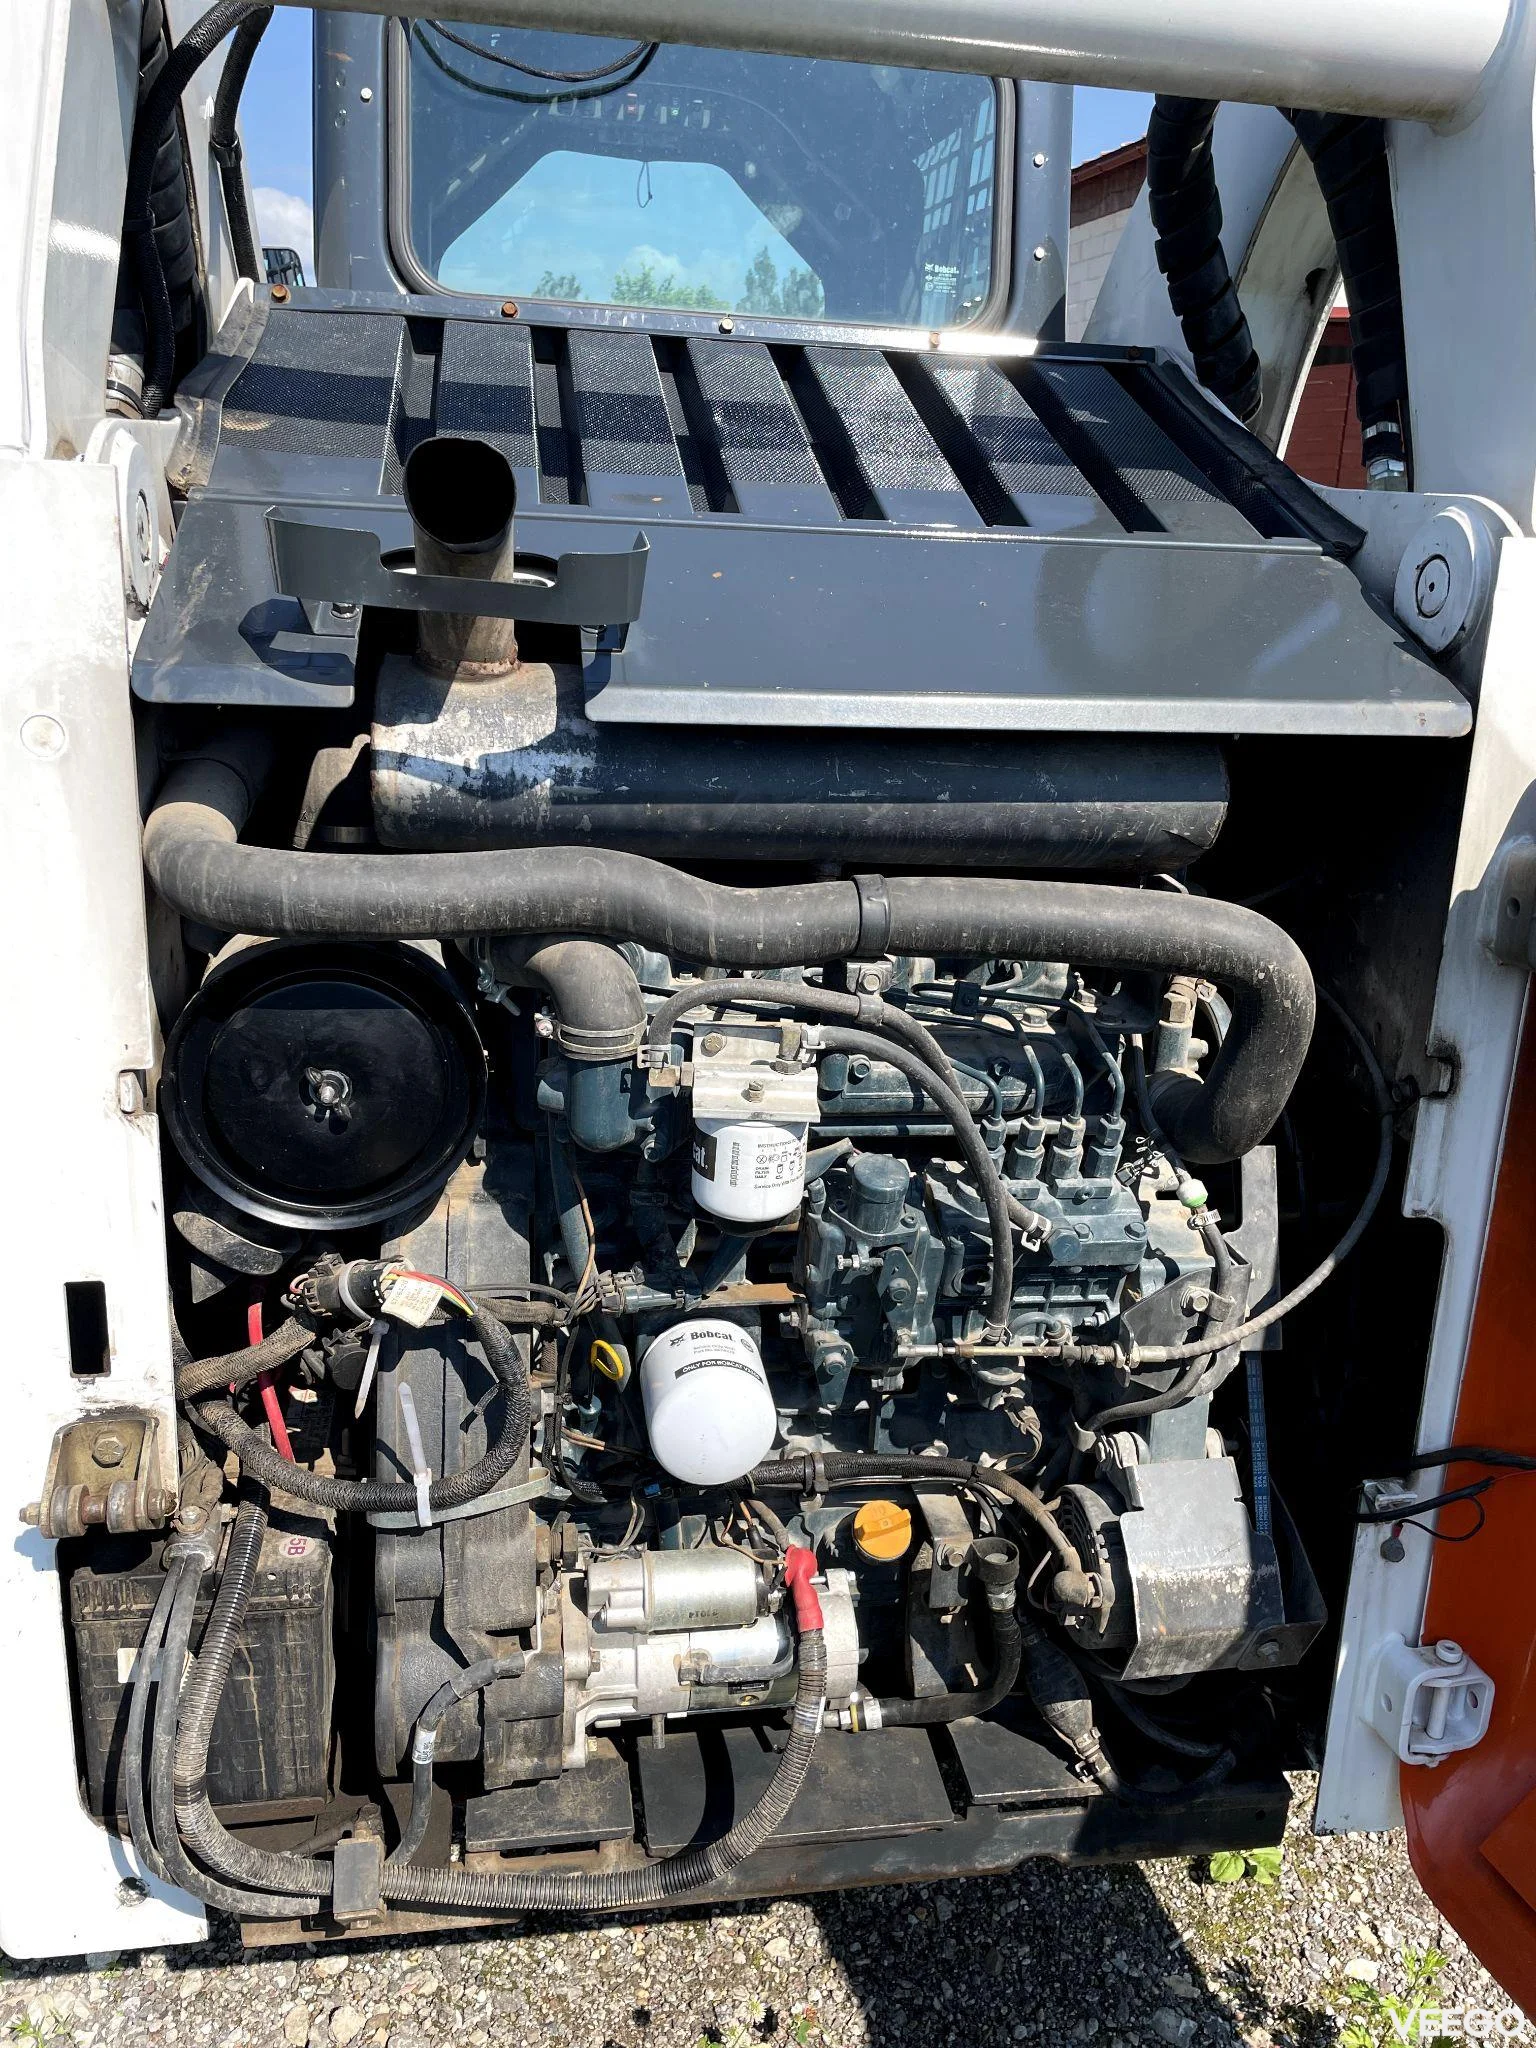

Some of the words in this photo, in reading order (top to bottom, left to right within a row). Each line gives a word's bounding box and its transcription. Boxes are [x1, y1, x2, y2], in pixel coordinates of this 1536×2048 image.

[934, 265, 957, 273] Bobcat
[690, 1331, 733, 1342] Bobcat
[682, 1362, 701, 1373] ONLY
[287, 1538, 307, 1555] 5B
